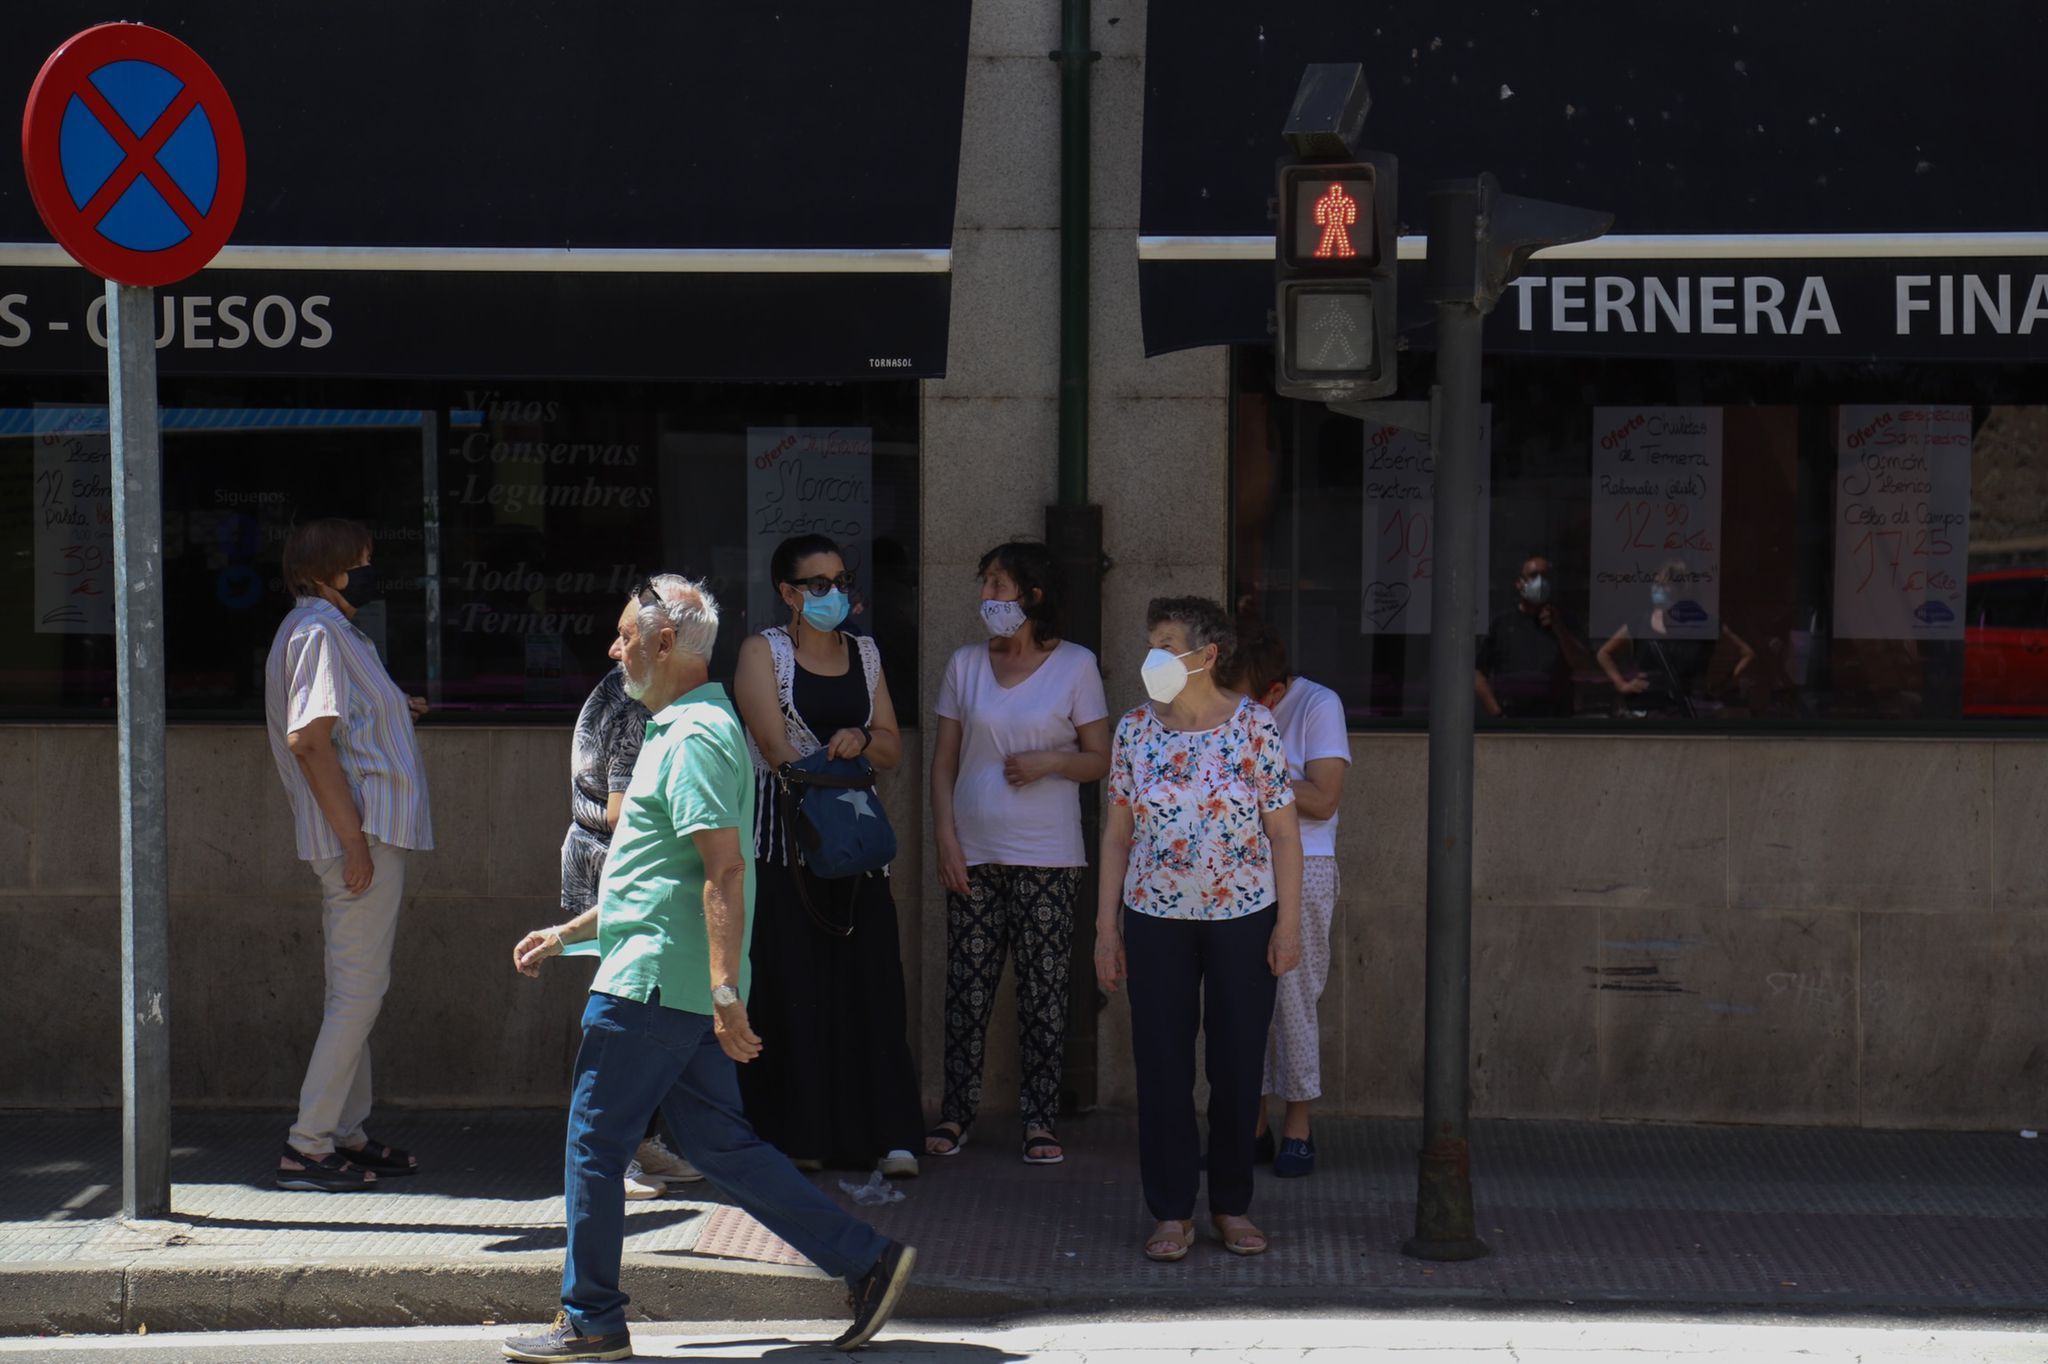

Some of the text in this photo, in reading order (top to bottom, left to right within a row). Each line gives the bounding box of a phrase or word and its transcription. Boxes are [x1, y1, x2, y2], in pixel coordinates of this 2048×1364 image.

[1507, 274, 2048, 335] TERNERA FINA
[868, 358, 912, 368] TORNASOL
[1600, 413, 1645, 450] Oferta
[1847, 411, 1893, 449] Oferta
[754, 434, 798, 470] Oferta
[1366, 446, 1434, 474] Ibéric
[555, 570, 596, 594] en
